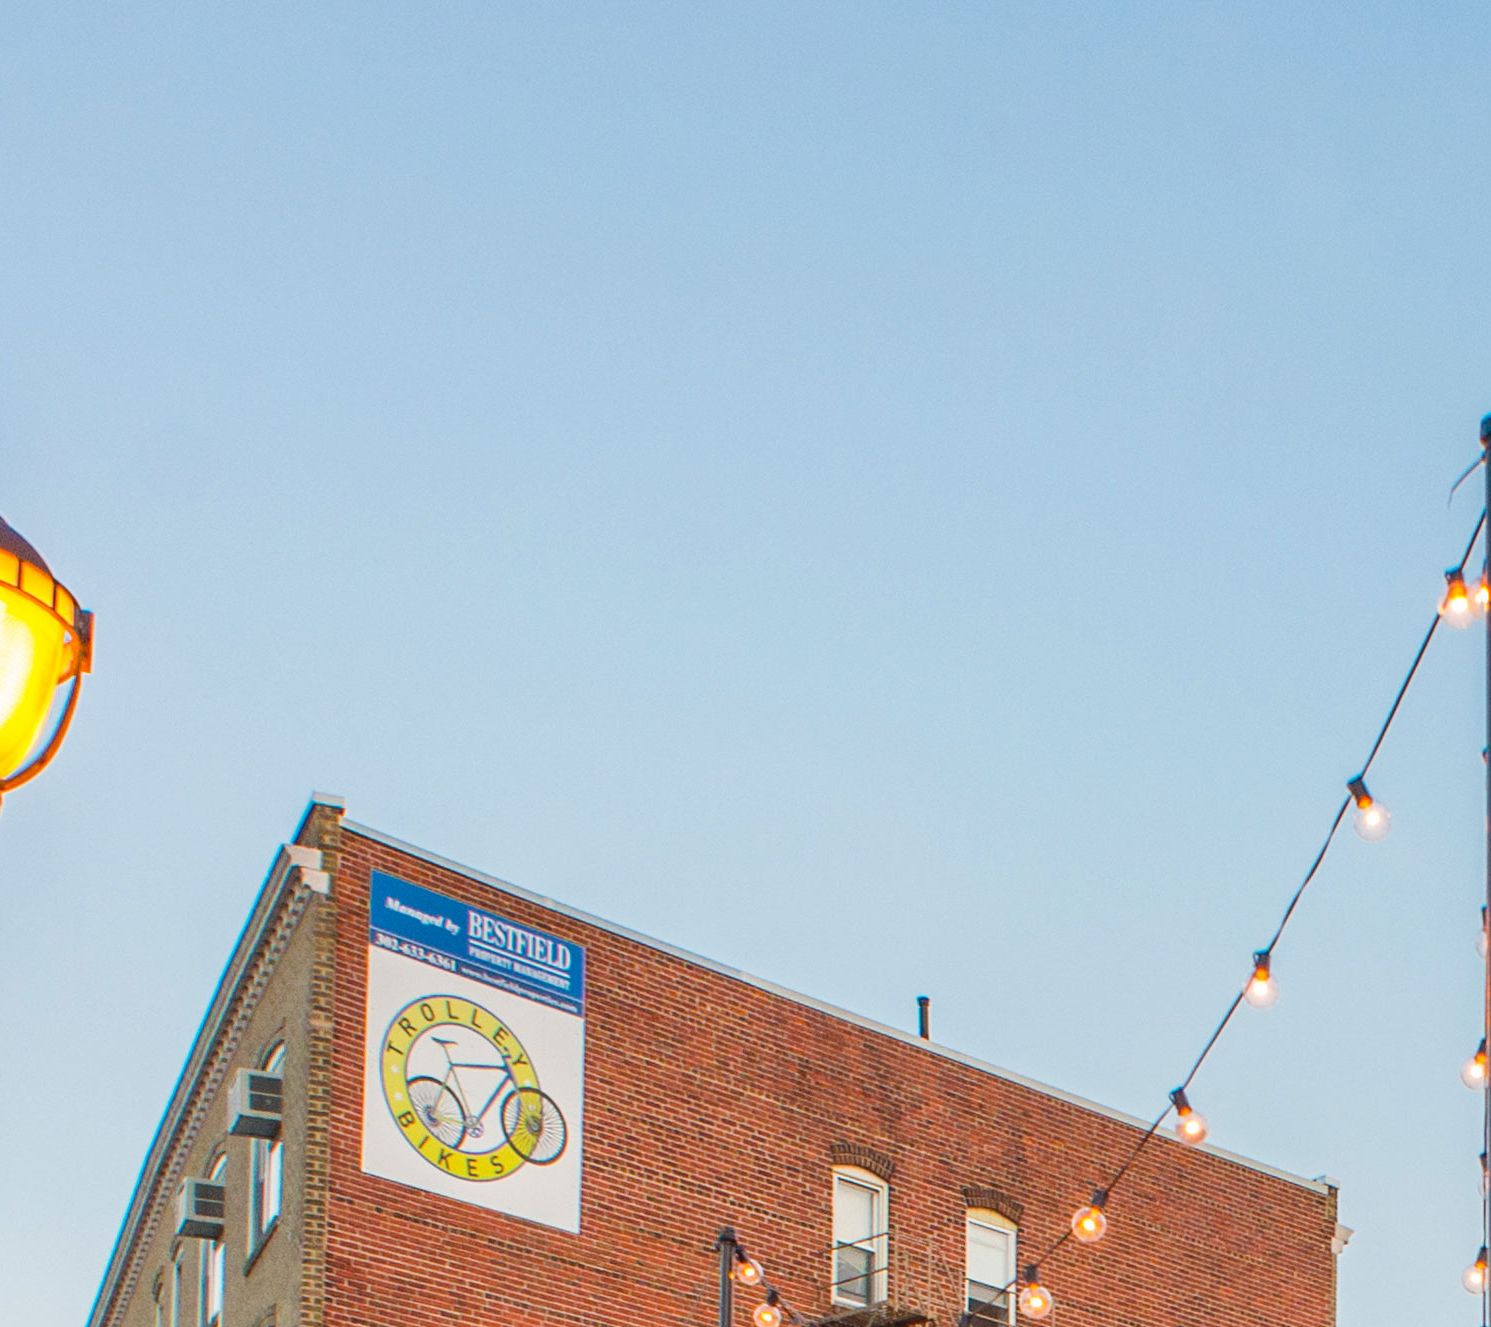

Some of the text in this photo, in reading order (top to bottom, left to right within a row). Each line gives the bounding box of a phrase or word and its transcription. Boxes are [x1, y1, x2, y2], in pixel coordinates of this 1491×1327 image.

[385, 896, 461, 935] Managed by
[468, 909, 571, 970] BESTFIELD
[468, 945, 512, 970] PROPERTY
[387, 1000, 528, 1068] TROLLEY
[396, 1110, 505, 1177] BIKES
